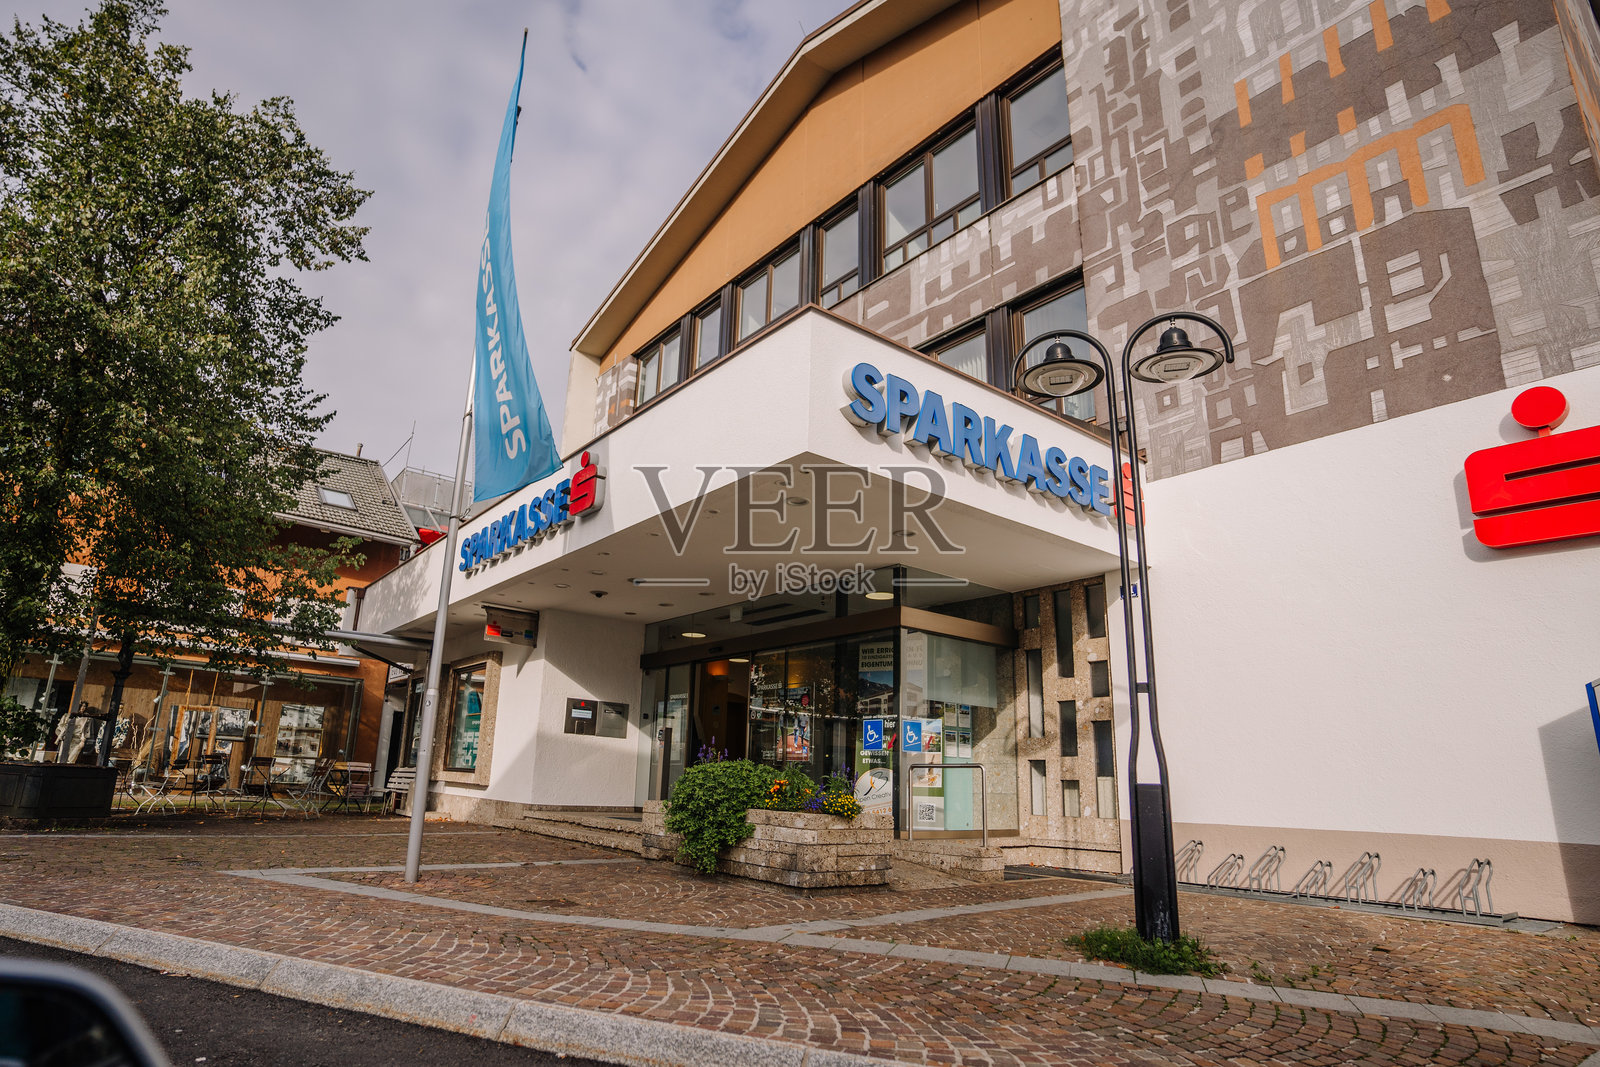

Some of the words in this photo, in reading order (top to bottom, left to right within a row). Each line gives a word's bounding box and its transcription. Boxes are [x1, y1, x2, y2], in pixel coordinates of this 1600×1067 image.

[849, 362, 1111, 516] SPARKASSE
[459, 478, 571, 572] SPARKASSE
[884, 720, 896, 728] hier
